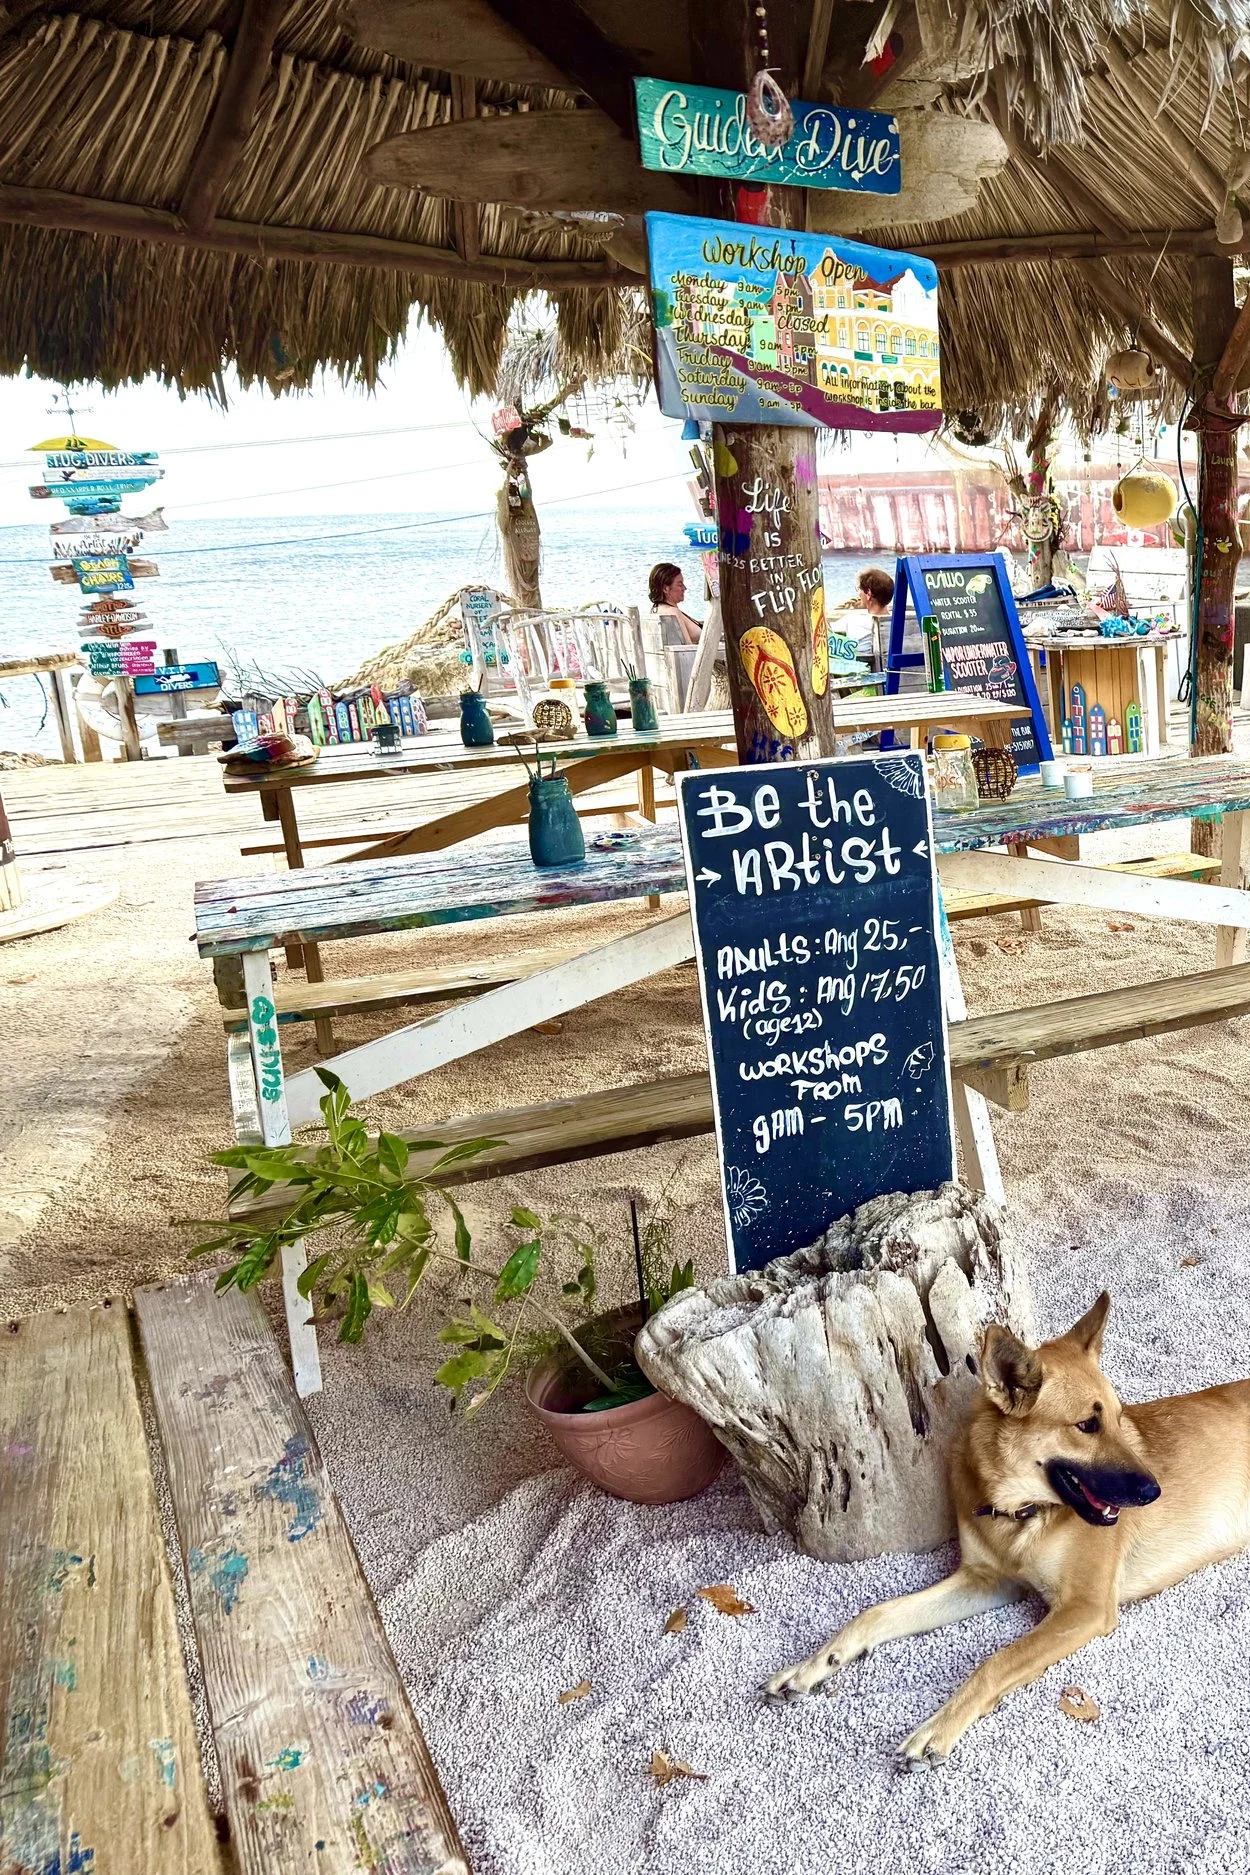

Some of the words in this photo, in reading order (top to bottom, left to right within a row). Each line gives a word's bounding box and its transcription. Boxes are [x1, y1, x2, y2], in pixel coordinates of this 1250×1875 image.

[796, 108, 893, 175] Dive
[703, 236, 806, 279] Workshop
[821, 255, 867, 282] Open
[670, 270, 727, 293] Monday
[737, 281, 764, 294] 9am
[776, 285, 800, 298] 5pm
[672, 288, 728, 312] Tuesday
[739, 299, 764, 311] 9am
[777, 301, 801, 315] 5pm
[673, 303, 754, 332] Wednesday
[672, 326, 752, 353] Thursday
[759, 339, 783, 351] 9am
[794, 344, 819, 356] 5pm
[676, 347, 733, 373] Friday
[748, 360, 774, 371] 9am
[785, 363, 809, 376] 5pm
[678, 368, 747, 393] Saturday
[825, 375, 838, 387] All
[681, 388, 738, 411] Sunday
[759, 398, 780, 408] 9am
[790, 401, 802, 412] 5p
[85, 452, 136, 466] DIVERS
[742, 476, 791, 530] Life
[764, 531, 781, 548] IS
[750, 553, 804, 574] BETTER
[82, 572, 125, 586] CHAIRS
[770, 572, 784, 585] IN
[932, 597, 952, 607] WATER
[952, 595, 976, 605] SCOOTER
[941, 626, 968, 636] DURATION
[950, 659, 988, 679] SCOOTER
[160, 681, 194, 691] DIVERS
[1011, 728, 1021, 737] THE
[1020, 726, 1032, 736] BAR
[697, 784, 780, 838] Be
[798, 776, 877, 829] the
[824, 927, 859, 970] Ang
[816, 974, 856, 1016] Ang
[790, 1073, 863, 1101] FROM
